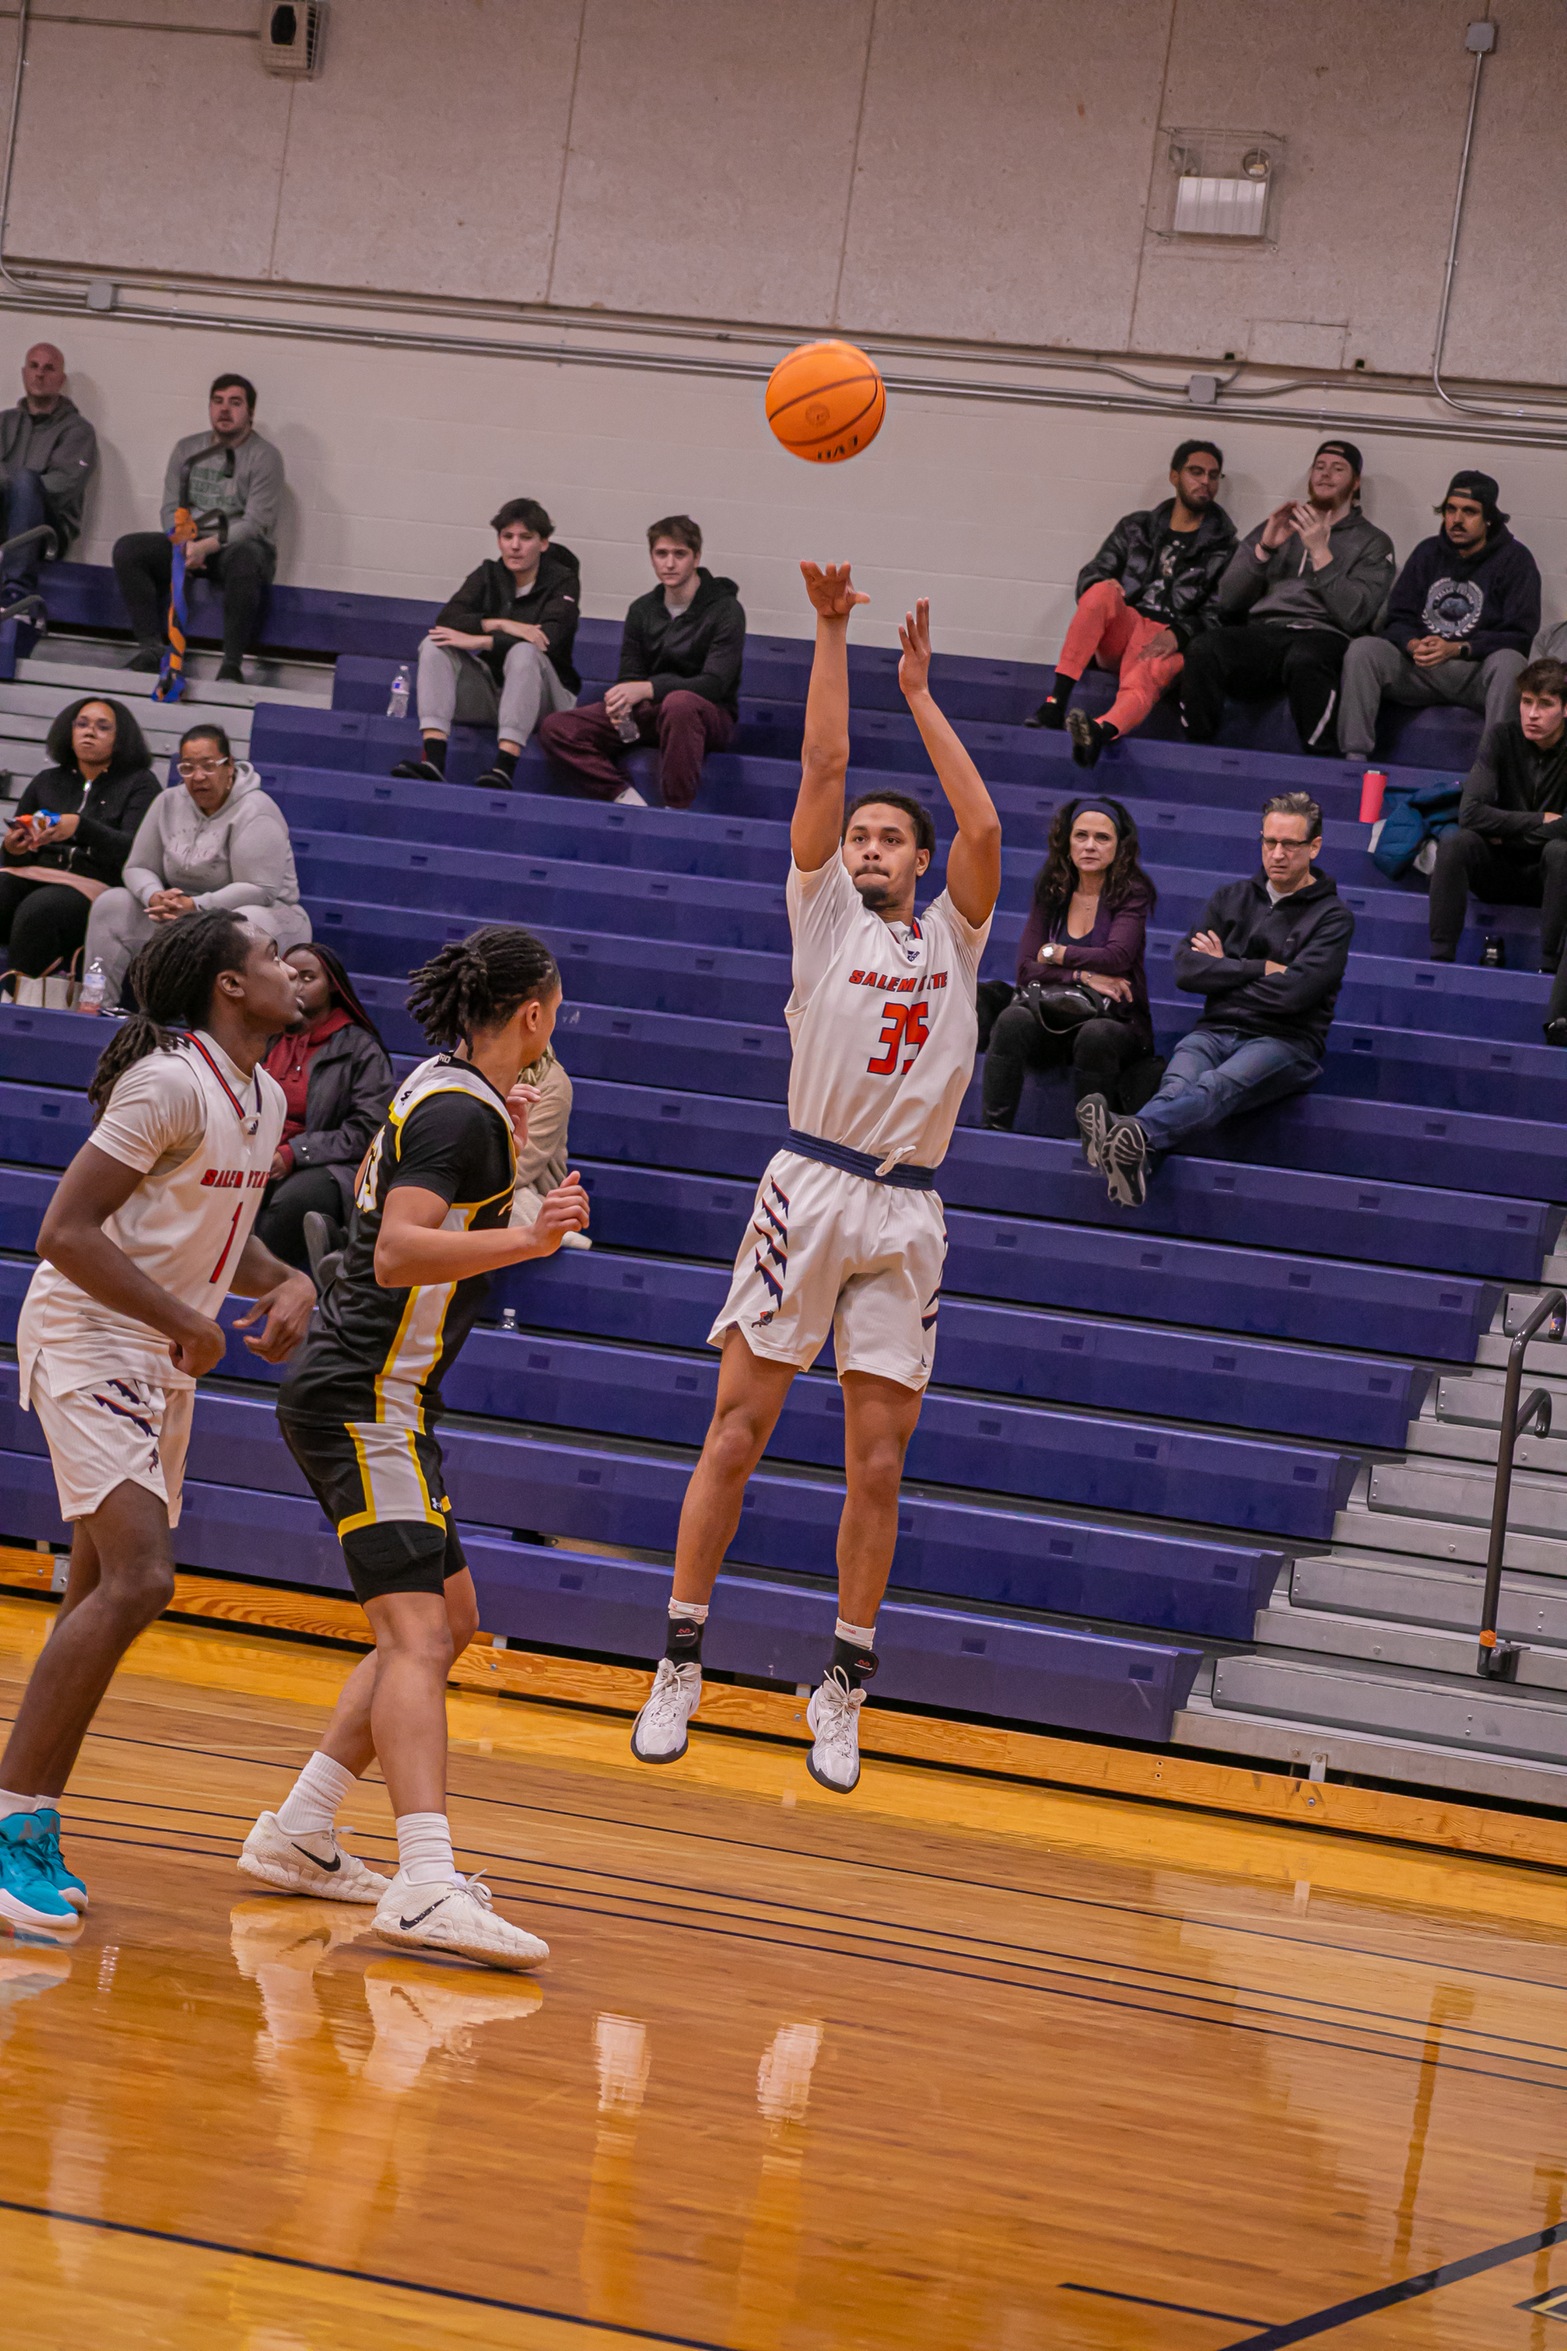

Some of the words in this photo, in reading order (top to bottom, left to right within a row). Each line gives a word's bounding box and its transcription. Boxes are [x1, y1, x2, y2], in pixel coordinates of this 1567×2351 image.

[849, 969, 918, 993] SALEM
[866, 1001, 930, 1076] 35
[208, 1201, 244, 1284] 1
